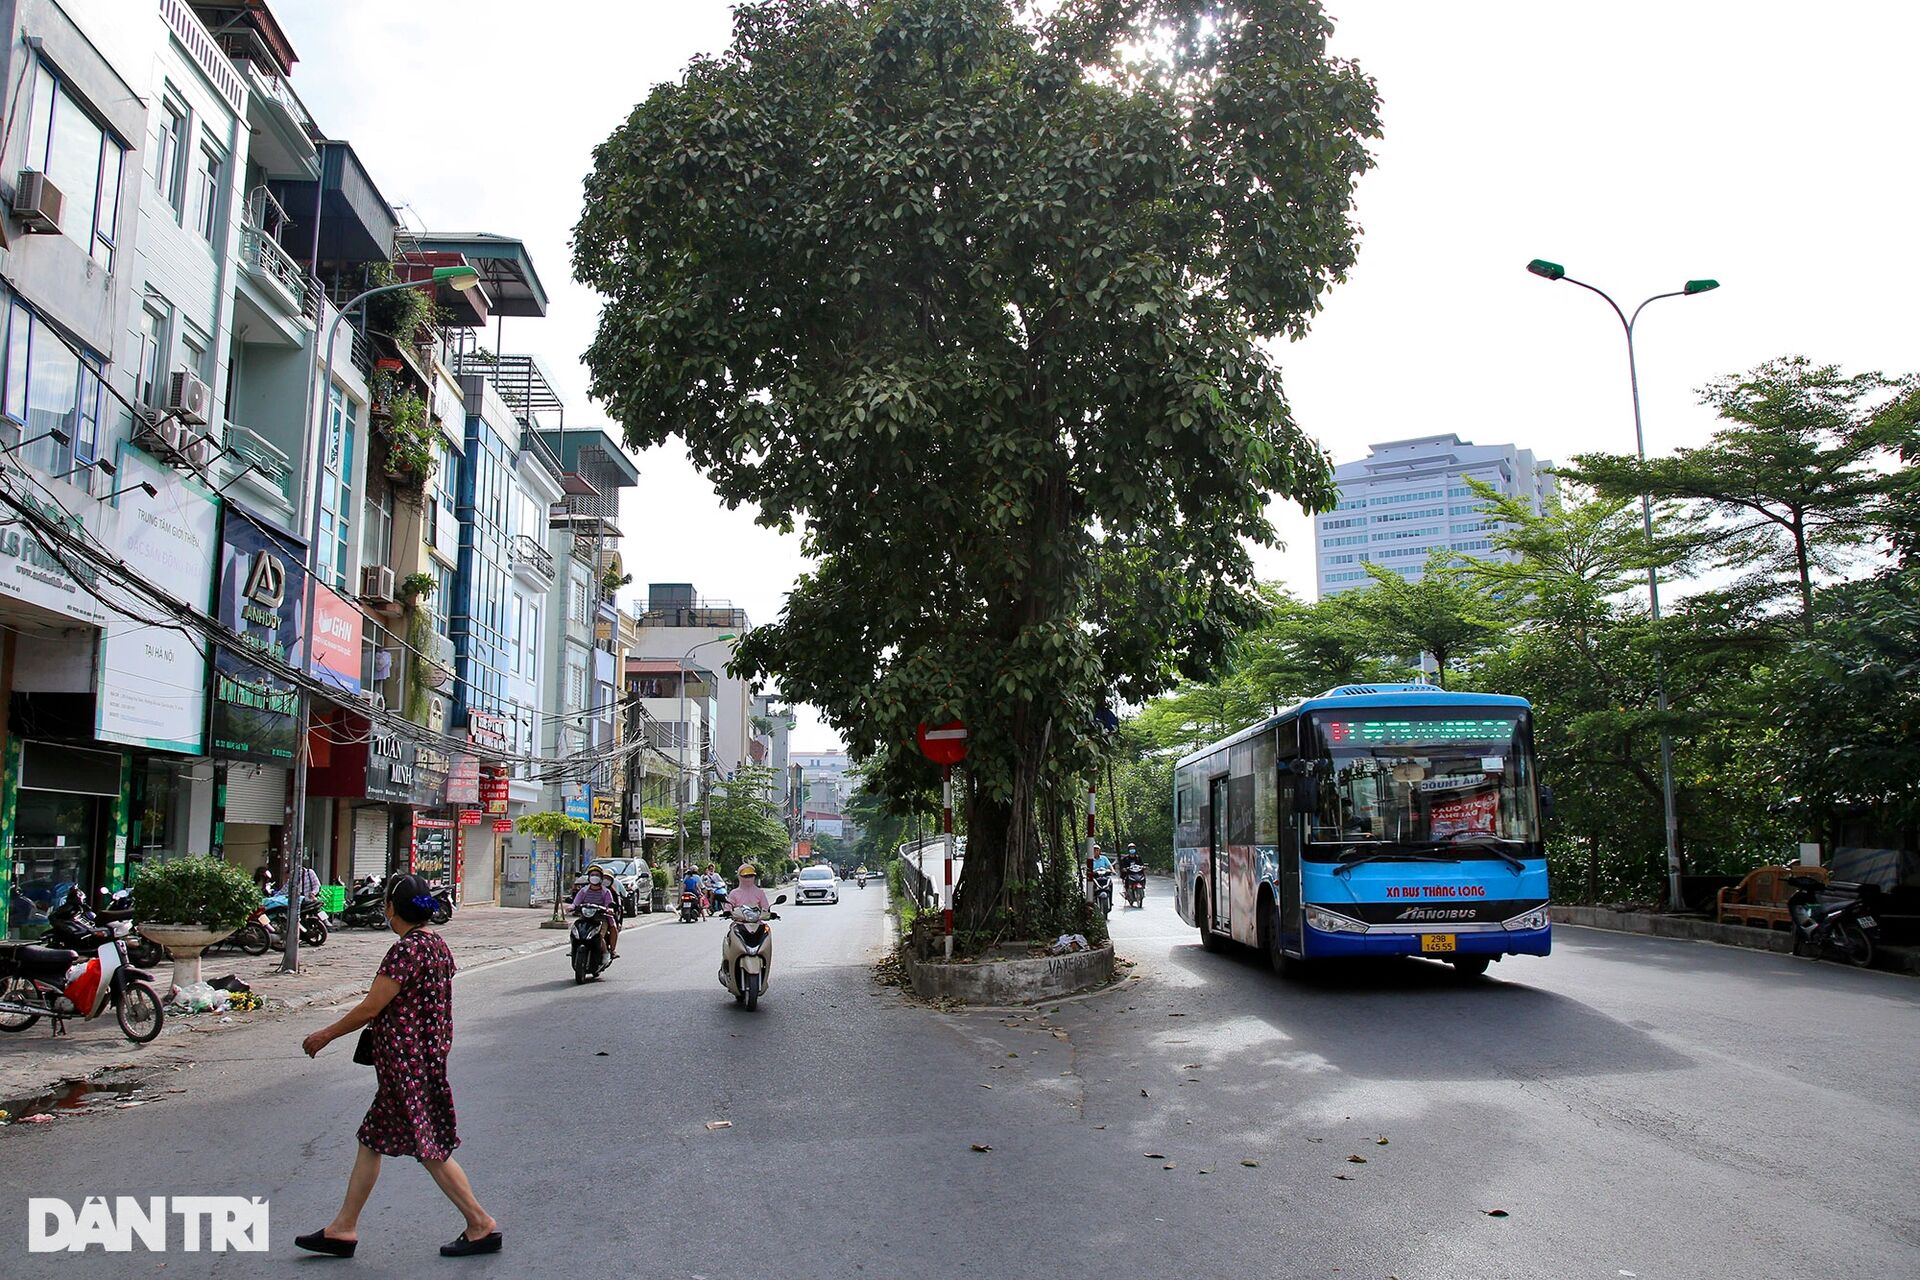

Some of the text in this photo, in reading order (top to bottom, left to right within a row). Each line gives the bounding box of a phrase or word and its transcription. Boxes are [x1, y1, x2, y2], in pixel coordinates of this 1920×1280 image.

[137, 508, 158, 527] TRUNG
[159, 518, 171, 534] TÂM
[331, 616, 352, 642] GHN
[154, 647, 163, 660] HÀ
[164, 648, 175, 663] NỘI
[377, 732, 403, 760] TUẤN
[391, 764, 412, 785] MINH
[1402, 887, 1420, 897] BUS
[1423, 884, 1456, 897] THĂNG
[1458, 886, 1485, 896] LONG
[1396, 906, 1477, 919] HANOIBUS
